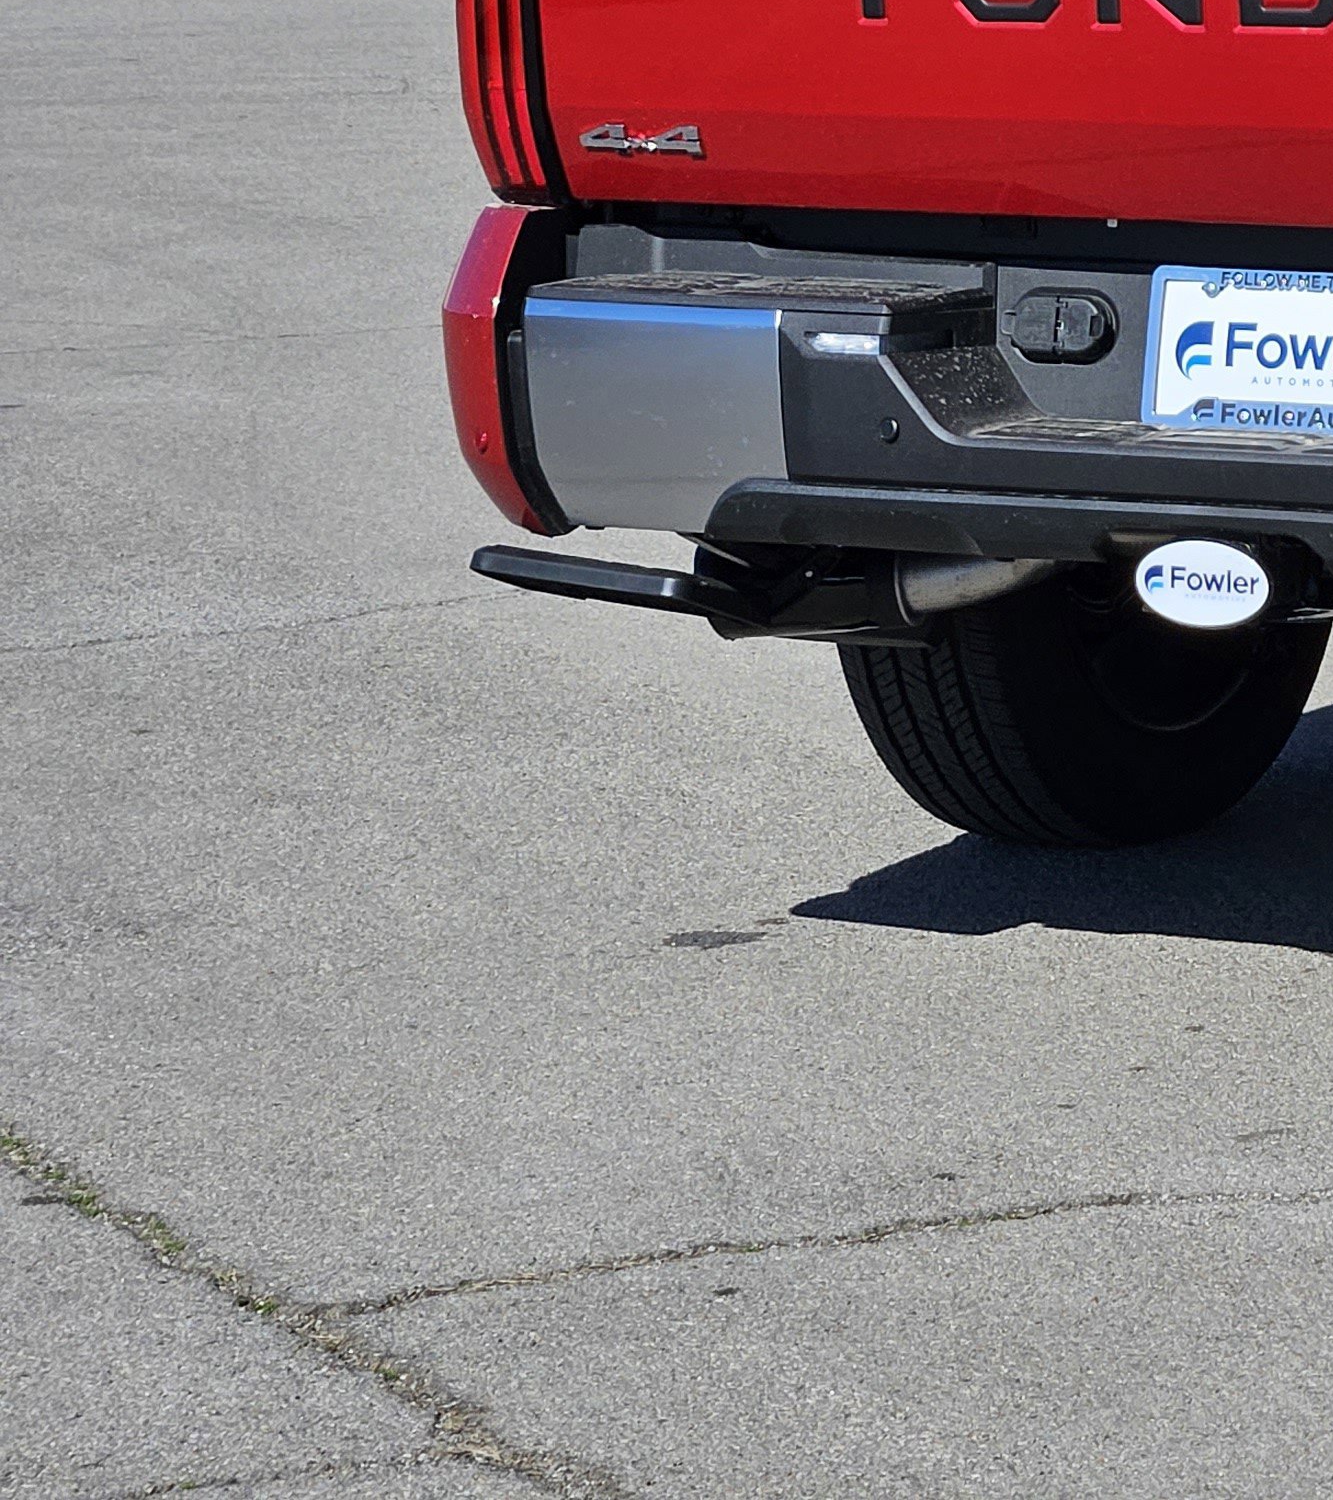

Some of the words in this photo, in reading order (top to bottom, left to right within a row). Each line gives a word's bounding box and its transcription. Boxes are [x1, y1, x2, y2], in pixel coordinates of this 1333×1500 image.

[1220, 271, 1293, 290] FOLLOW
[1297, 274, 1322, 290] ME
[1171, 566, 1259, 594] Fowler
